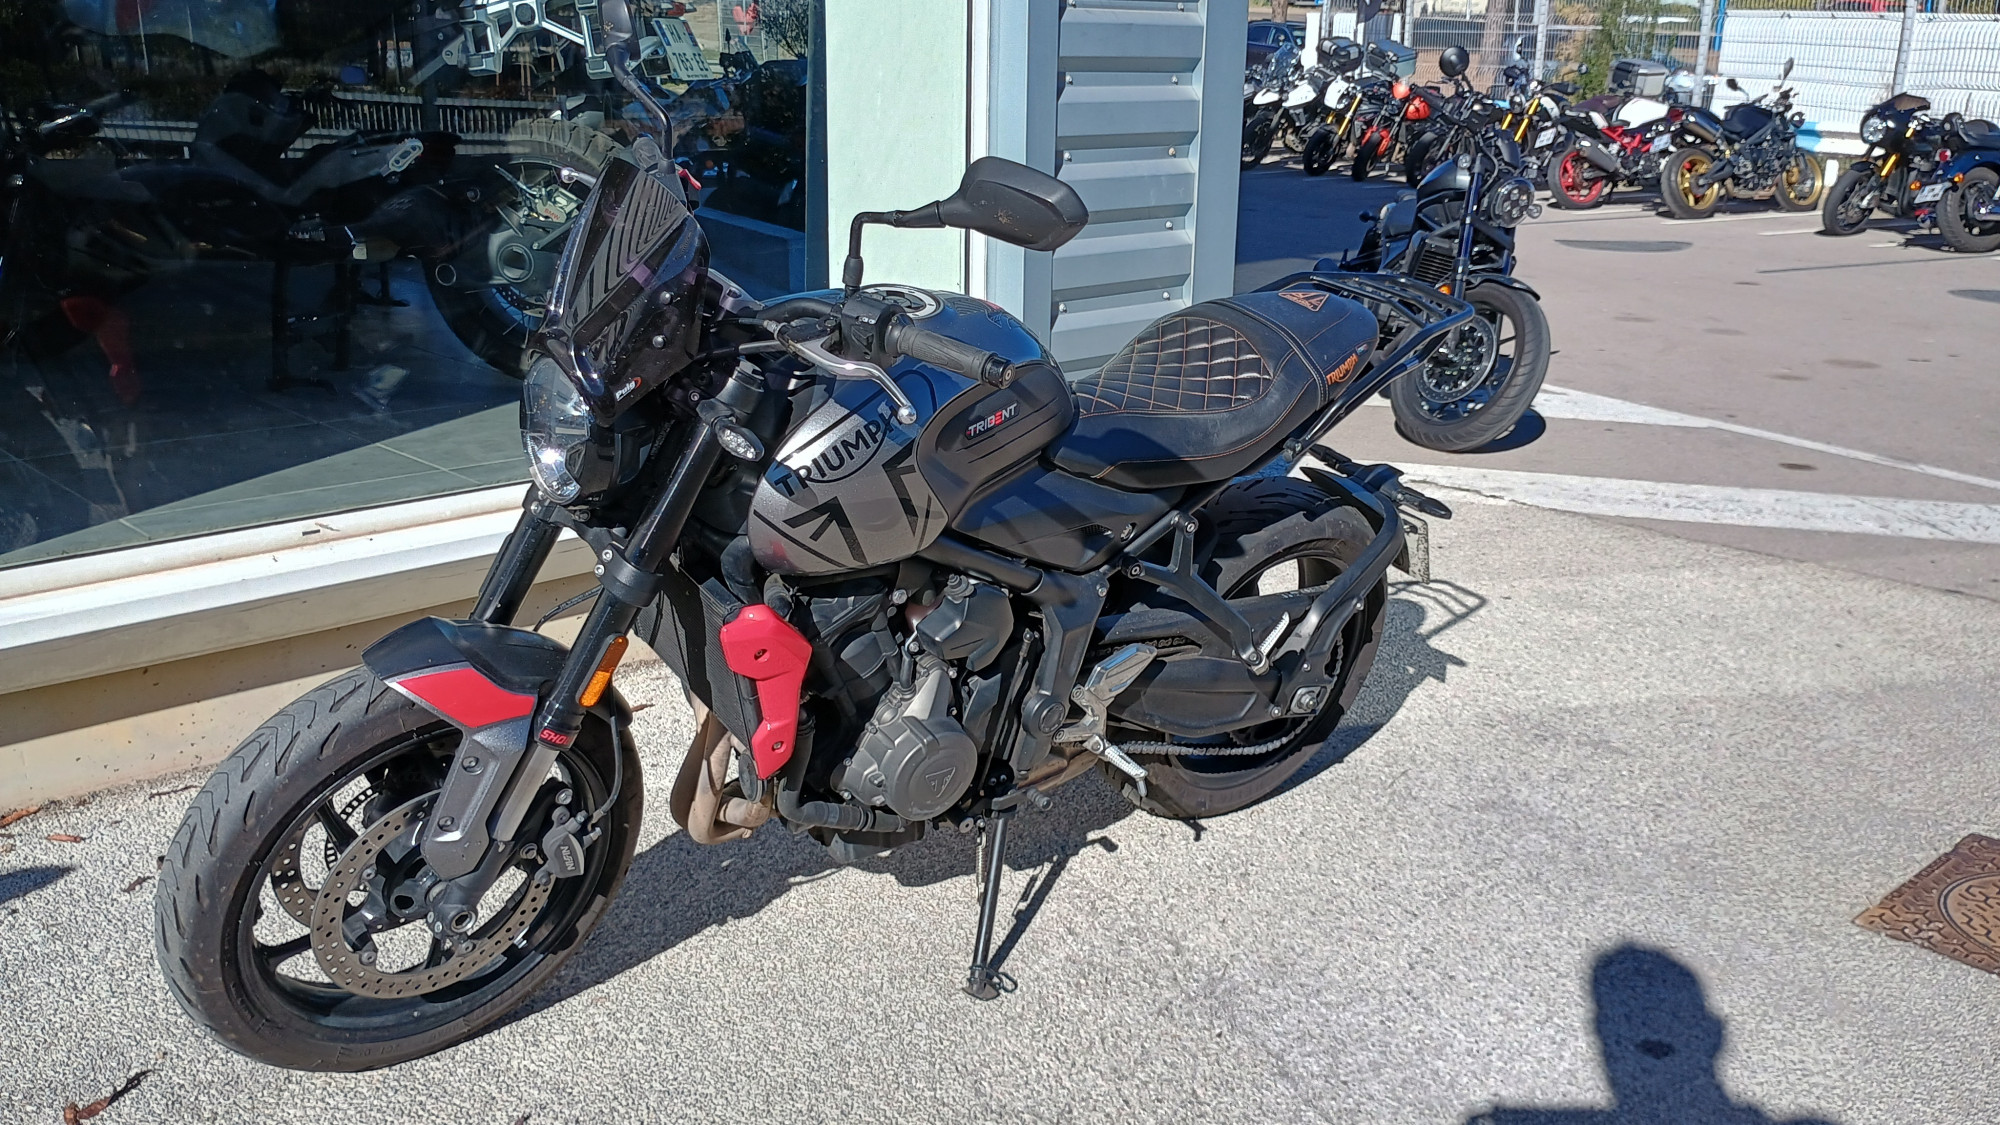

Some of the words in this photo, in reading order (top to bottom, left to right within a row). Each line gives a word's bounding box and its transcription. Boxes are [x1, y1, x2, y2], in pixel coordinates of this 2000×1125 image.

[544, 208, 560, 220] BMW
[1326, 353, 1358, 385] TRIUMPH
[967, 403, 1017, 436] TRIDENT
[774, 404, 902, 497] TRIUMPH
